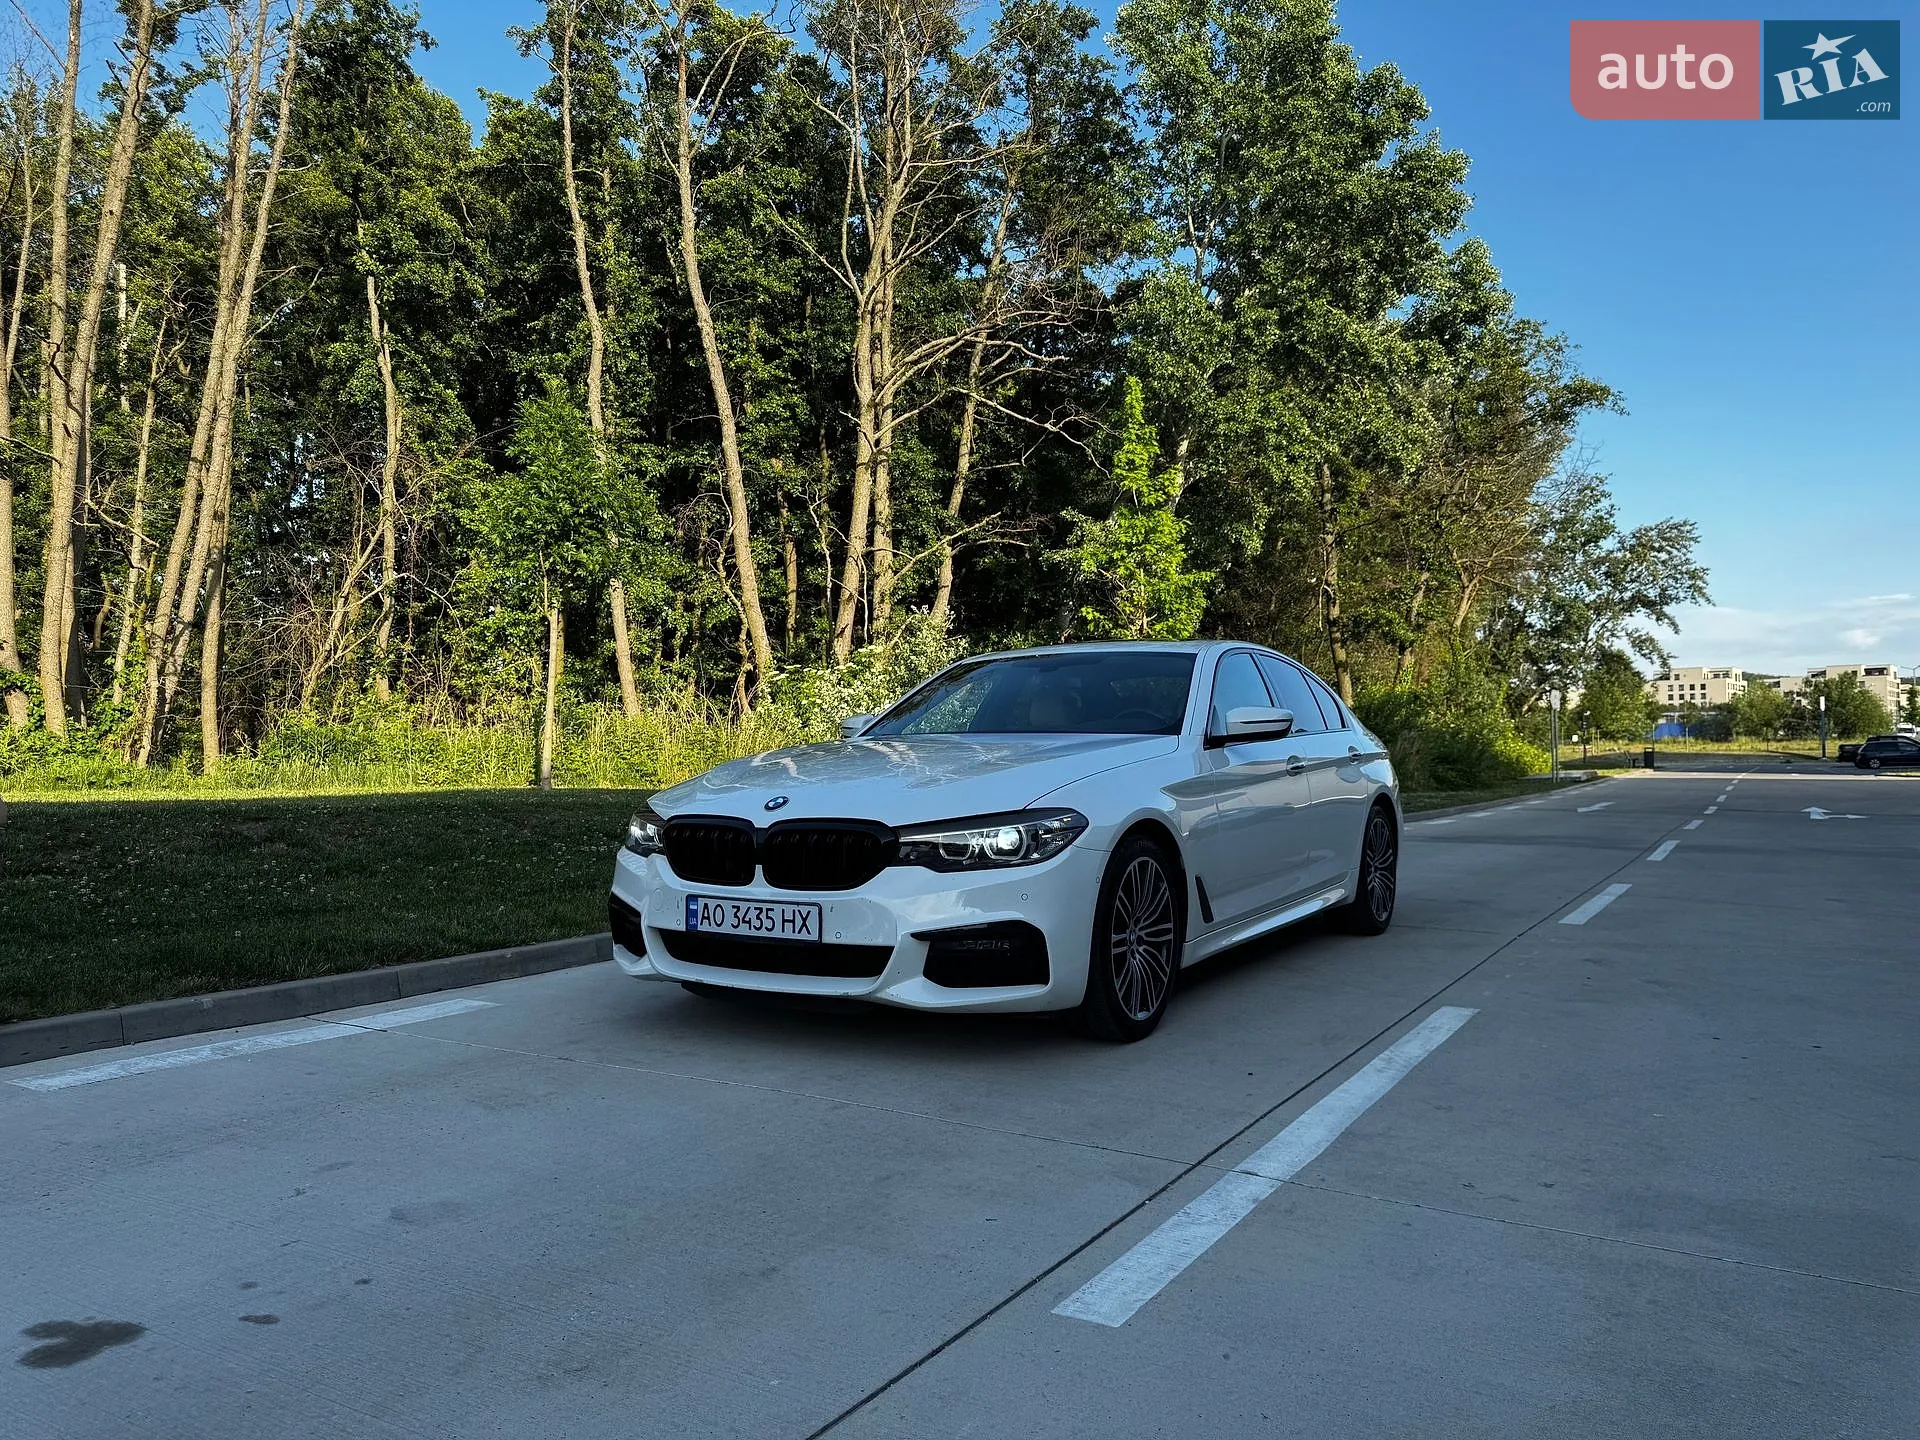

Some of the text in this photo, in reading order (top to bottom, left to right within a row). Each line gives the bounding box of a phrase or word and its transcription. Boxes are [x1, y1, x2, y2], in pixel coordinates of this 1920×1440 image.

[689, 917, 697, 925] UA
[700, 902, 812, 935] AO 3435 HX
